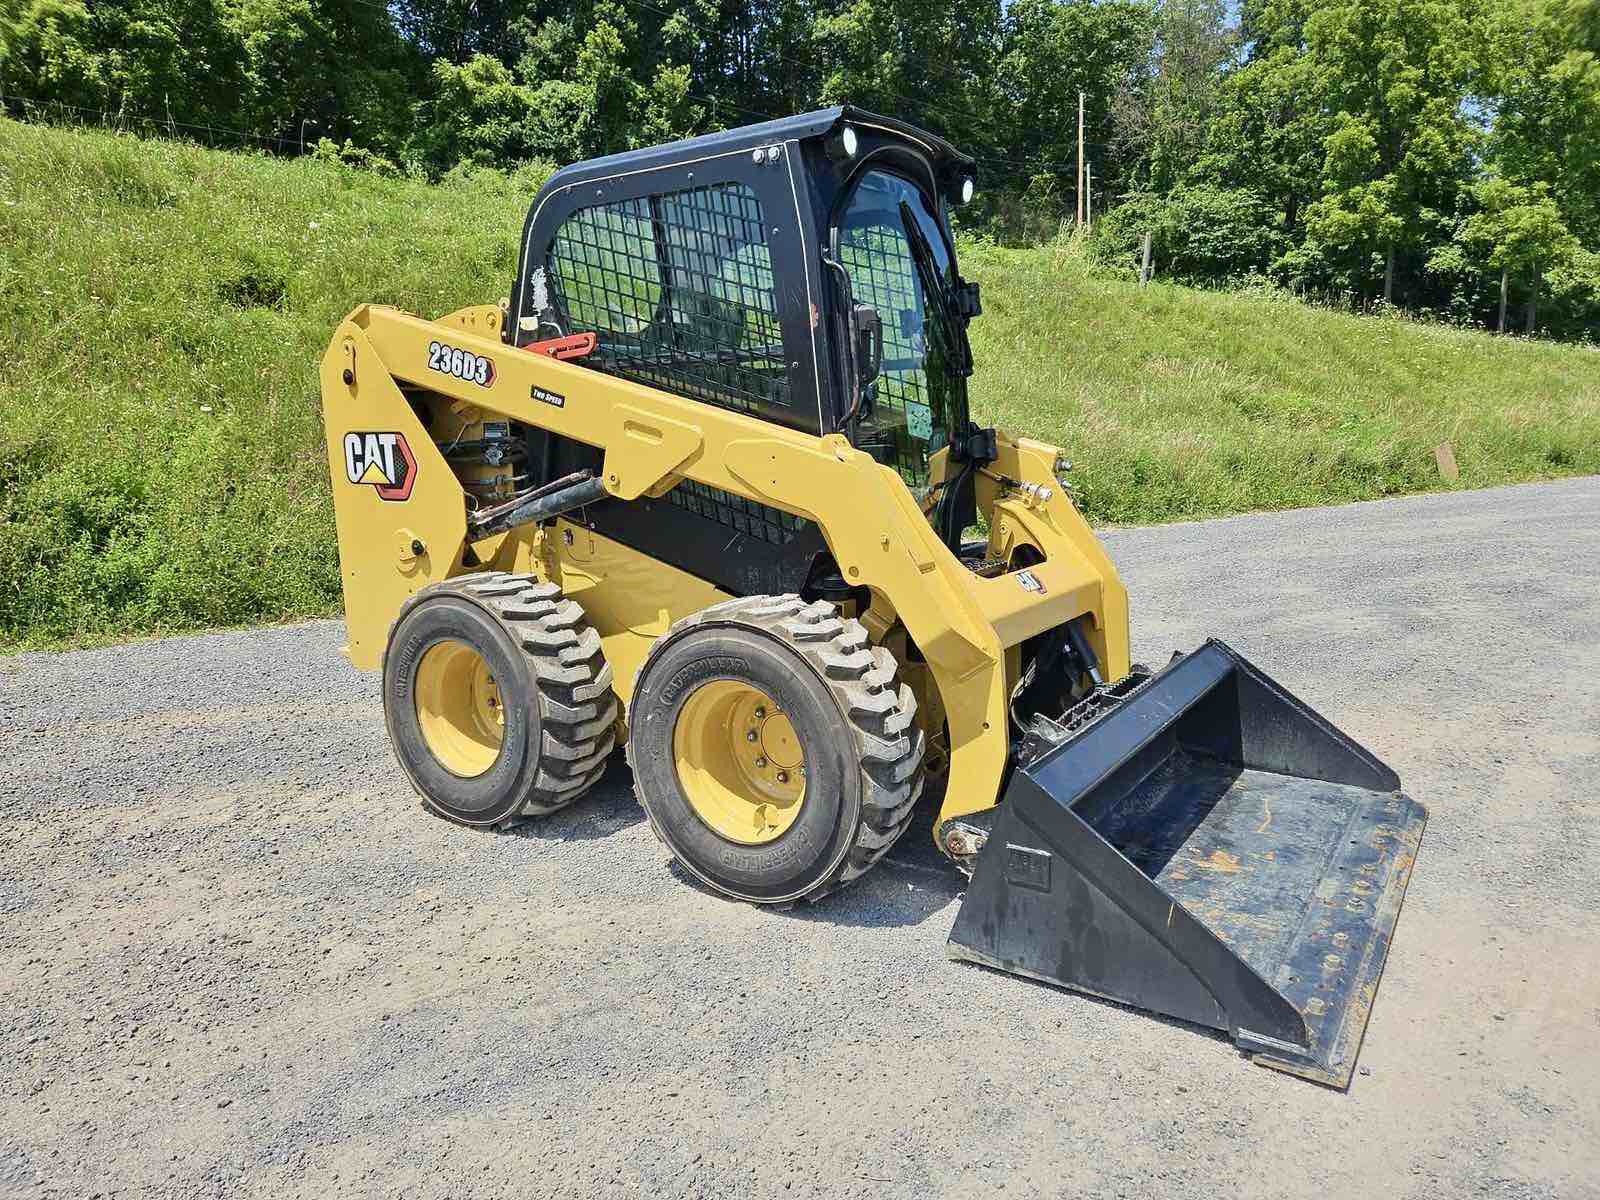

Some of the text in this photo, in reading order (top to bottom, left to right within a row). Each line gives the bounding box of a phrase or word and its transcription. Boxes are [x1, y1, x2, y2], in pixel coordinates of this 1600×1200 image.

[428, 342, 488, 385] 236D3
[545, 393, 562, 405] SPEED
[345, 432, 396, 484] CAT
